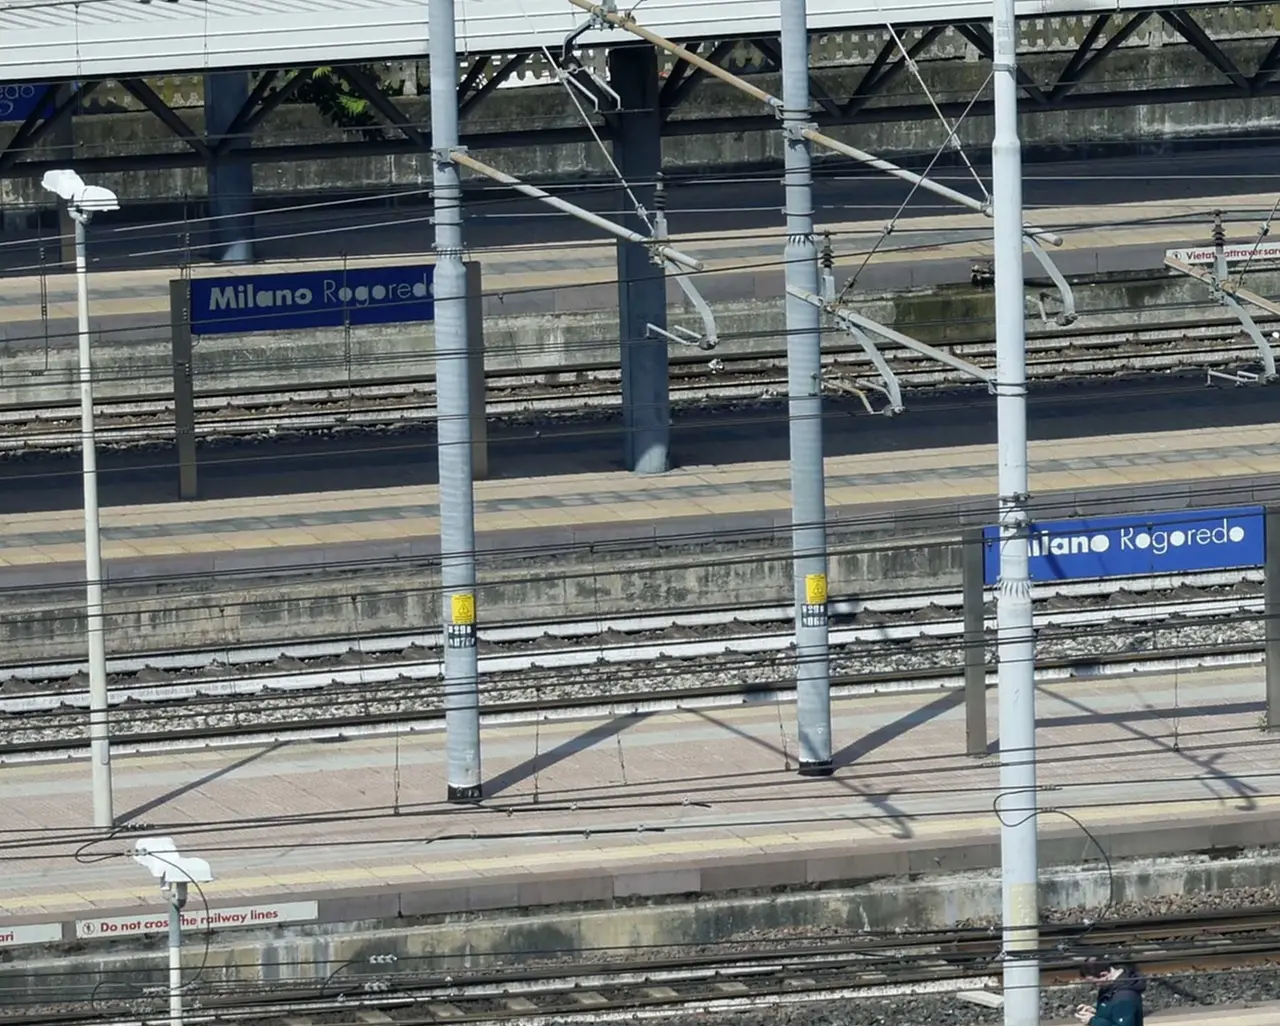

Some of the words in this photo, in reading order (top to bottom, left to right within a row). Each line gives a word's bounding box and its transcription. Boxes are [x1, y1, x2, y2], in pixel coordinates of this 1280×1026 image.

[1186, 251, 1217, 261] Vietat
[209, 283, 313, 311] Milano
[1028, 530, 1110, 558] ilano
[1121, 518, 1245, 555] Rogoredo
[100, 921, 117, 933] Do
[120, 919, 142, 932] not
[144, 917, 170, 931] cros
[200, 910, 246, 927] railway
[250, 908, 279, 921] lines
